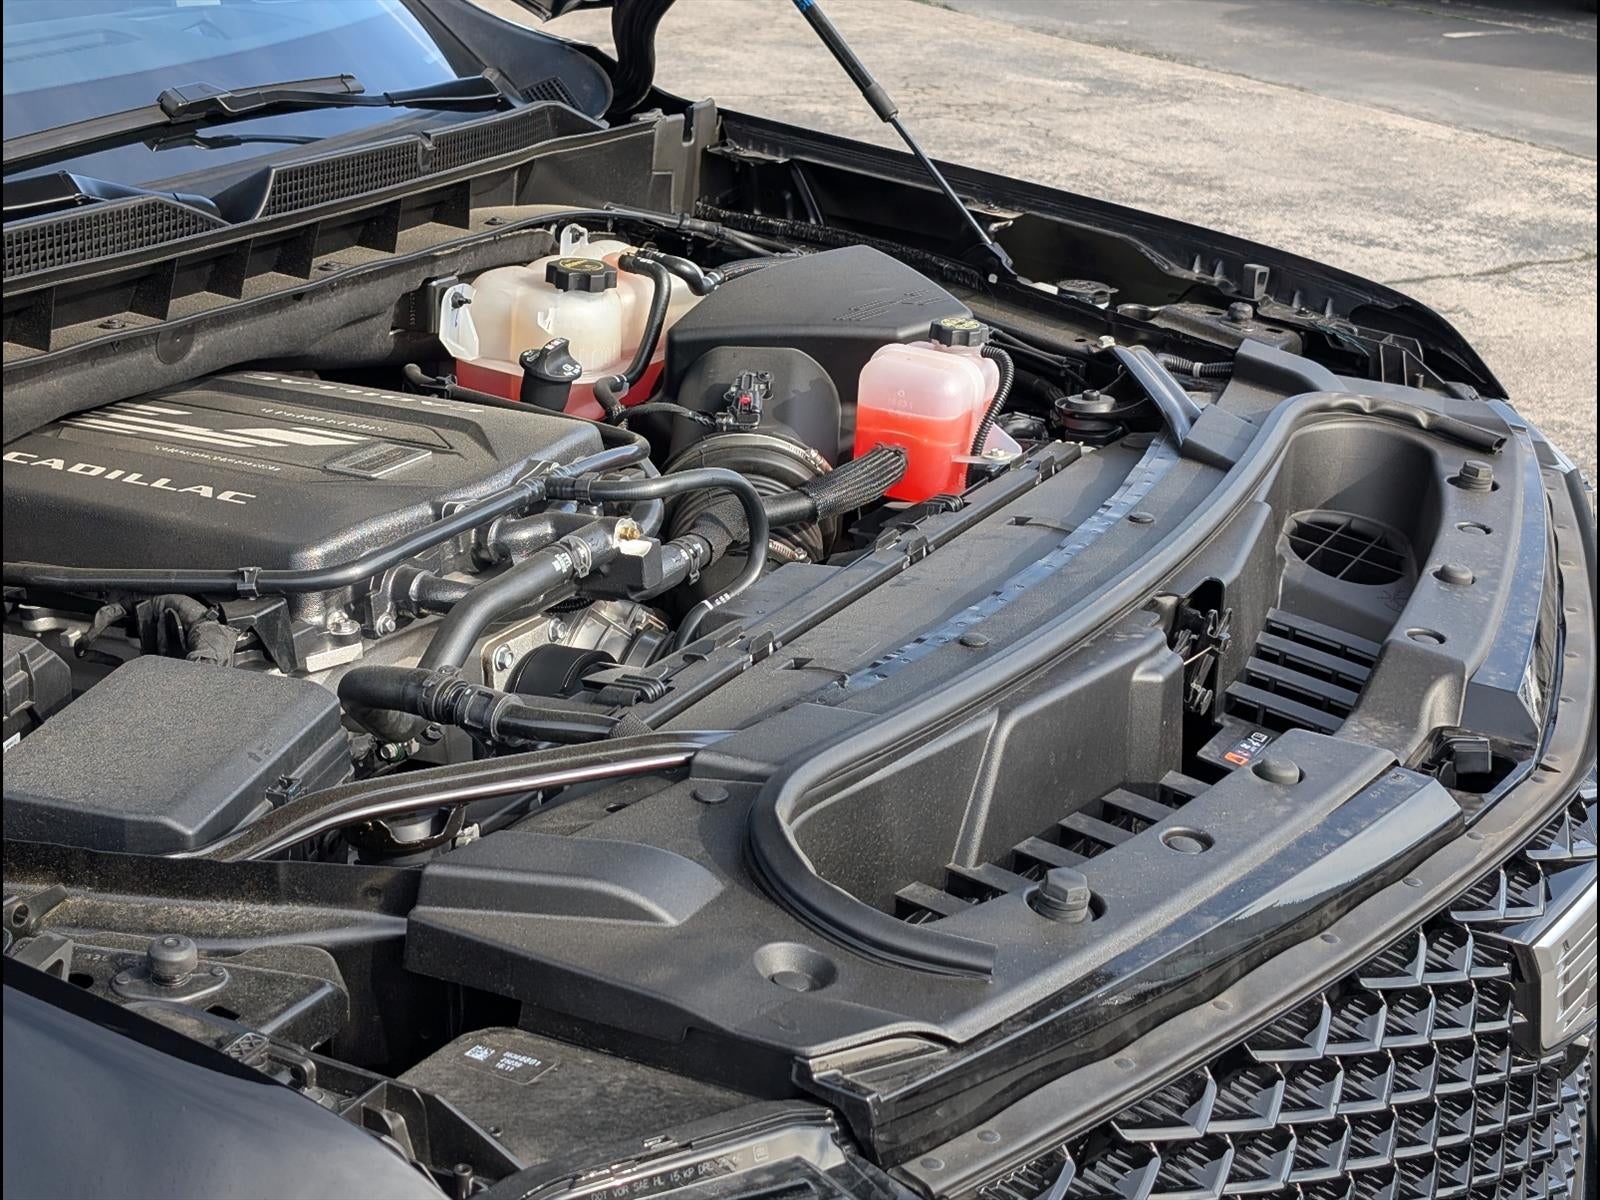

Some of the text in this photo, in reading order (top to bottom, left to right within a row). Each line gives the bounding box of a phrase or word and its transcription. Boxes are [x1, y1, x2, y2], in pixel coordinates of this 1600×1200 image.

[3, 451, 257, 505] CADILLAC
[633, 1179, 649, 1193] SAE
[653, 1174, 665, 1187] HL
